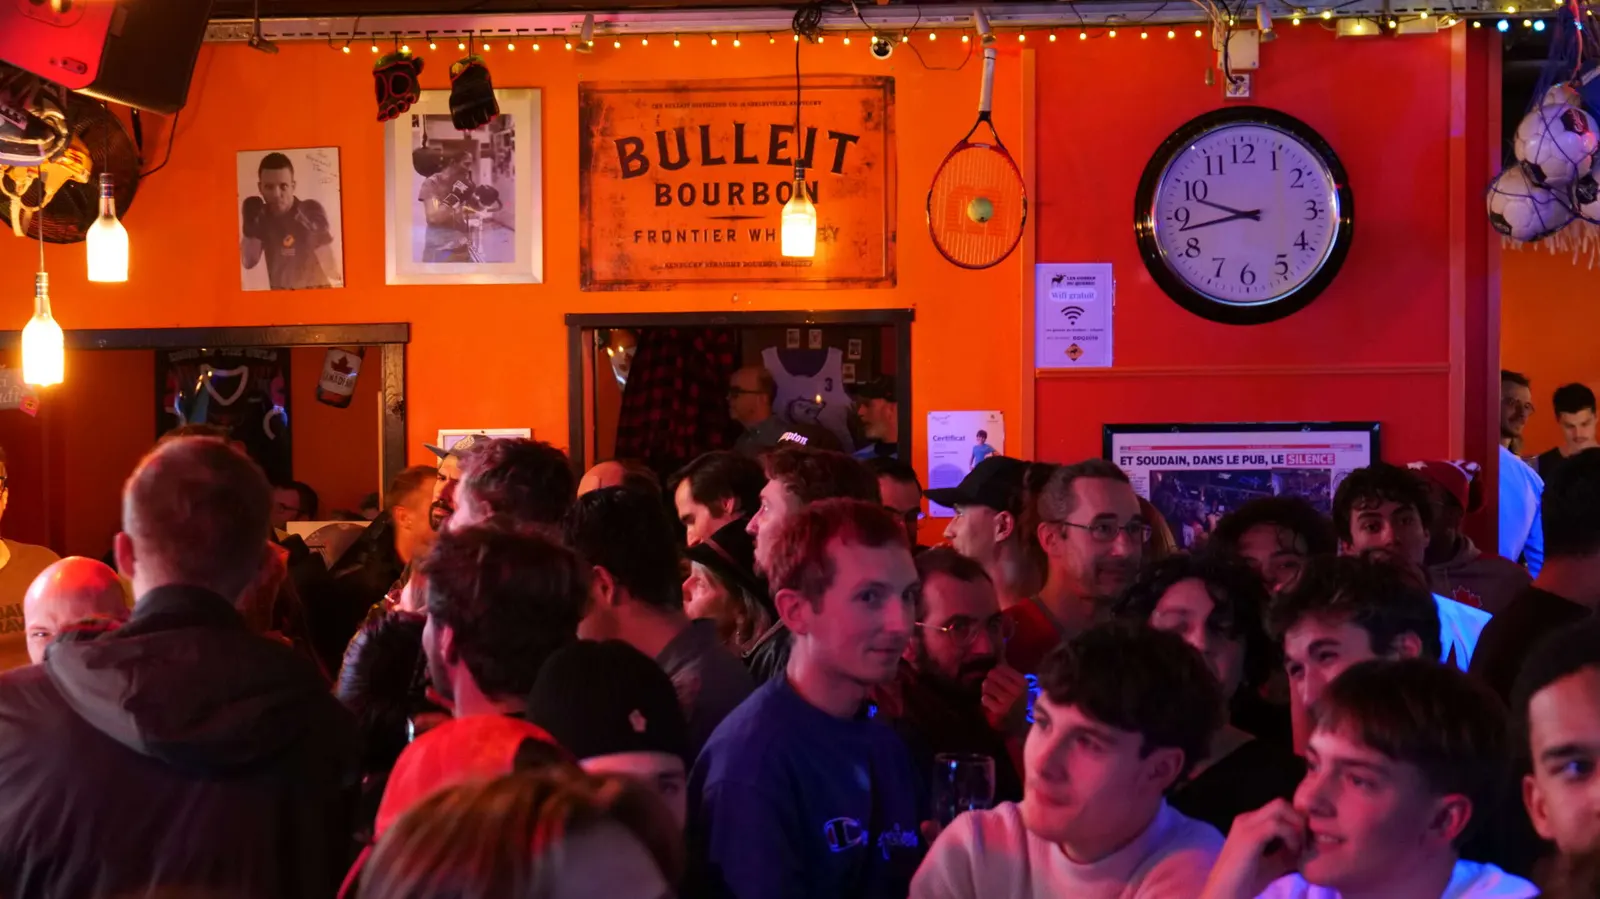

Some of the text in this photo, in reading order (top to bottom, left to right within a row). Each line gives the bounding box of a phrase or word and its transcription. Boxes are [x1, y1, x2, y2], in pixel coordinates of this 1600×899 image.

[614, 123, 860, 179] BULLEIT
[1231, 143, 1256, 164] 12
[1270, 150, 1279, 171] 1
[1205, 154, 1226, 176] 11
[1289, 168, 1304, 189] 2
[655, 180, 819, 207] BOURBON
[1184, 179, 1208, 201] 10
[1174, 206, 1190, 231] 9
[1304, 199, 1318, 221] 3
[633, 227, 840, 244] FRONTIER WHEY
[1293, 230, 1309, 251] 4
[1184, 237, 1201, 258] 8
[1212, 257, 1226, 278] 7
[1240, 263, 1256, 286] 6
[1275, 254, 1289, 276] 5
[1051, 291, 1094, 300] Wifi gratuit
[824, 377, 833, 392] 3
[932, 434, 966, 442] Certificat
[1120, 454, 1334, 467] ET SOUDAIN, DANS LE PUB, LE SILENCE
